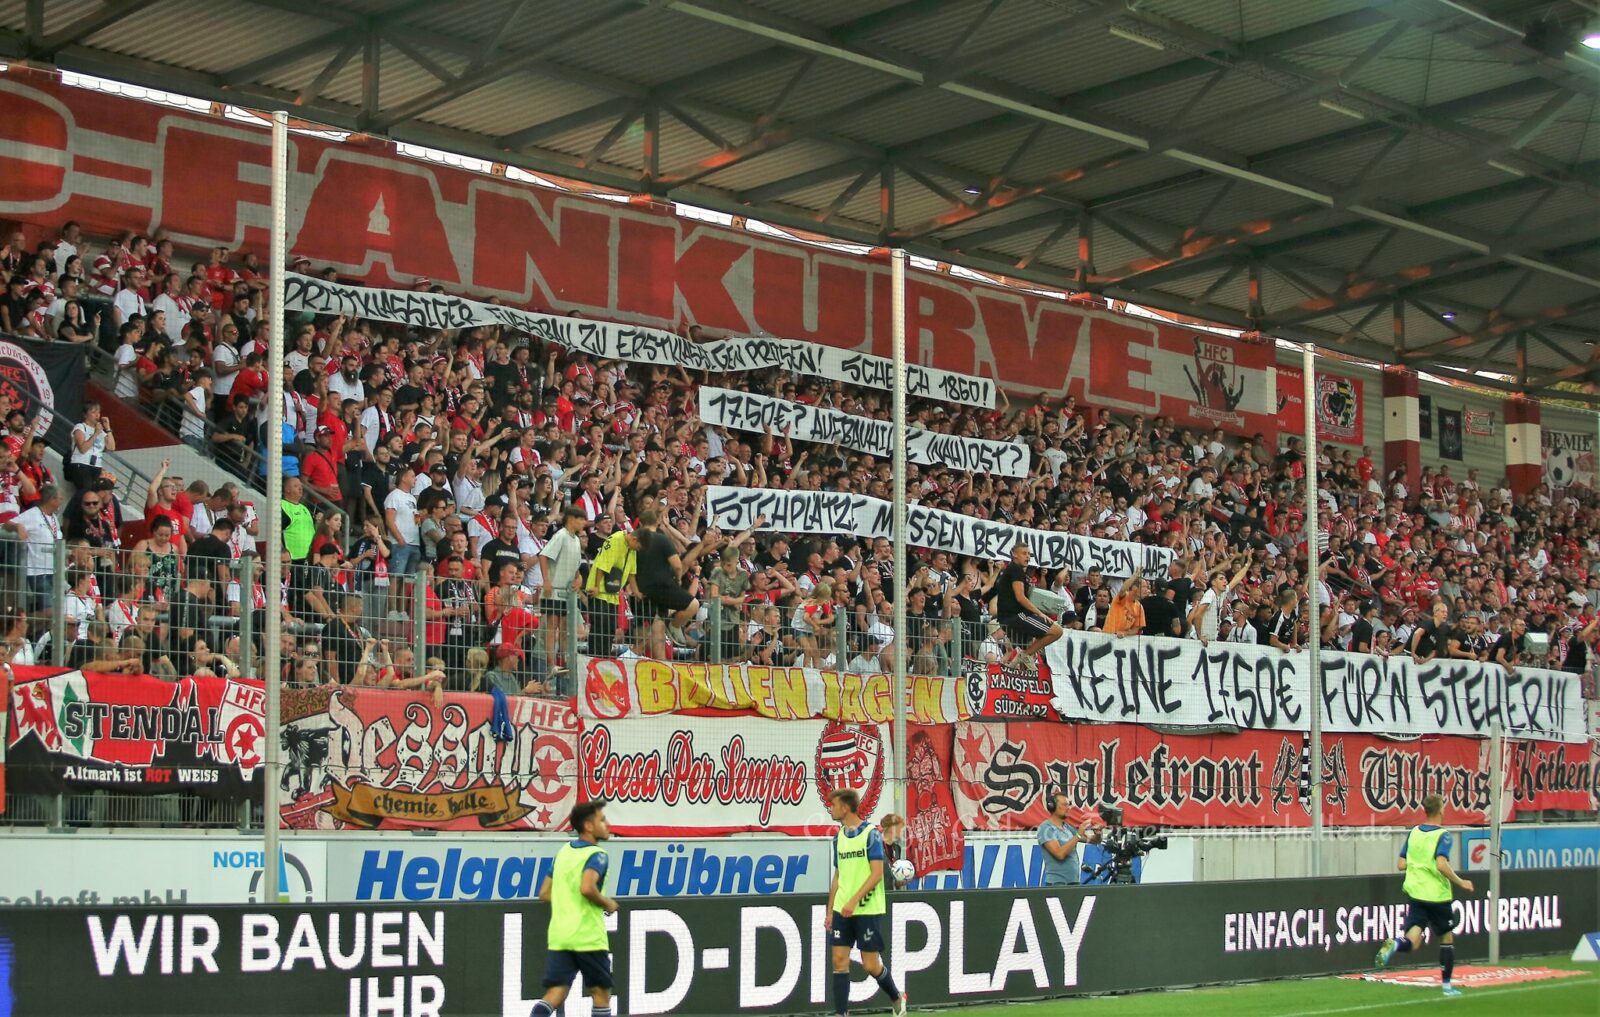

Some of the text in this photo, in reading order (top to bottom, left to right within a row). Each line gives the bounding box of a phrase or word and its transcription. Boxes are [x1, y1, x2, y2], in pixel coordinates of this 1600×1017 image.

[578, 323, 607, 356] ZU
[842, 354, 930, 395] SCHECH
[938, 374, 990, 405] 1860!
[1203, 343, 1228, 362] HFC
[708, 392, 807, 435] 17,50€?
[809, 408, 924, 461] AUFBAUHILE
[872, 504, 966, 549] MSSEN
[990, 673, 1051, 695] MANSFELD
[1067, 636, 1568, 741] KEINE 17,50€ FÜR'N STEHER!!!
[63, 701, 225, 744] STENDAL
[530, 699, 578, 730] HFC
[63, 766, 219, 783] Altmark ist ROT WEISS
[580, 723, 807, 827] Coesa Per Sempre
[982, 738, 1264, 815] Saalefront
[615, 843, 810, 898] Hübner
[838, 849, 866, 859] hummel
[1501, 847, 1600, 869] RADIO BRO
[86, 911, 445, 976] WIR BAUEN
[1224, 908, 1331, 951] EINFACH,
[1335, 903, 1431, 945] SCHNE,
[1451, 899, 1480, 935] ON
[502, 895, 1096, 1017] LD-DIPLAY
[349, 974, 446, 1017] IHR
